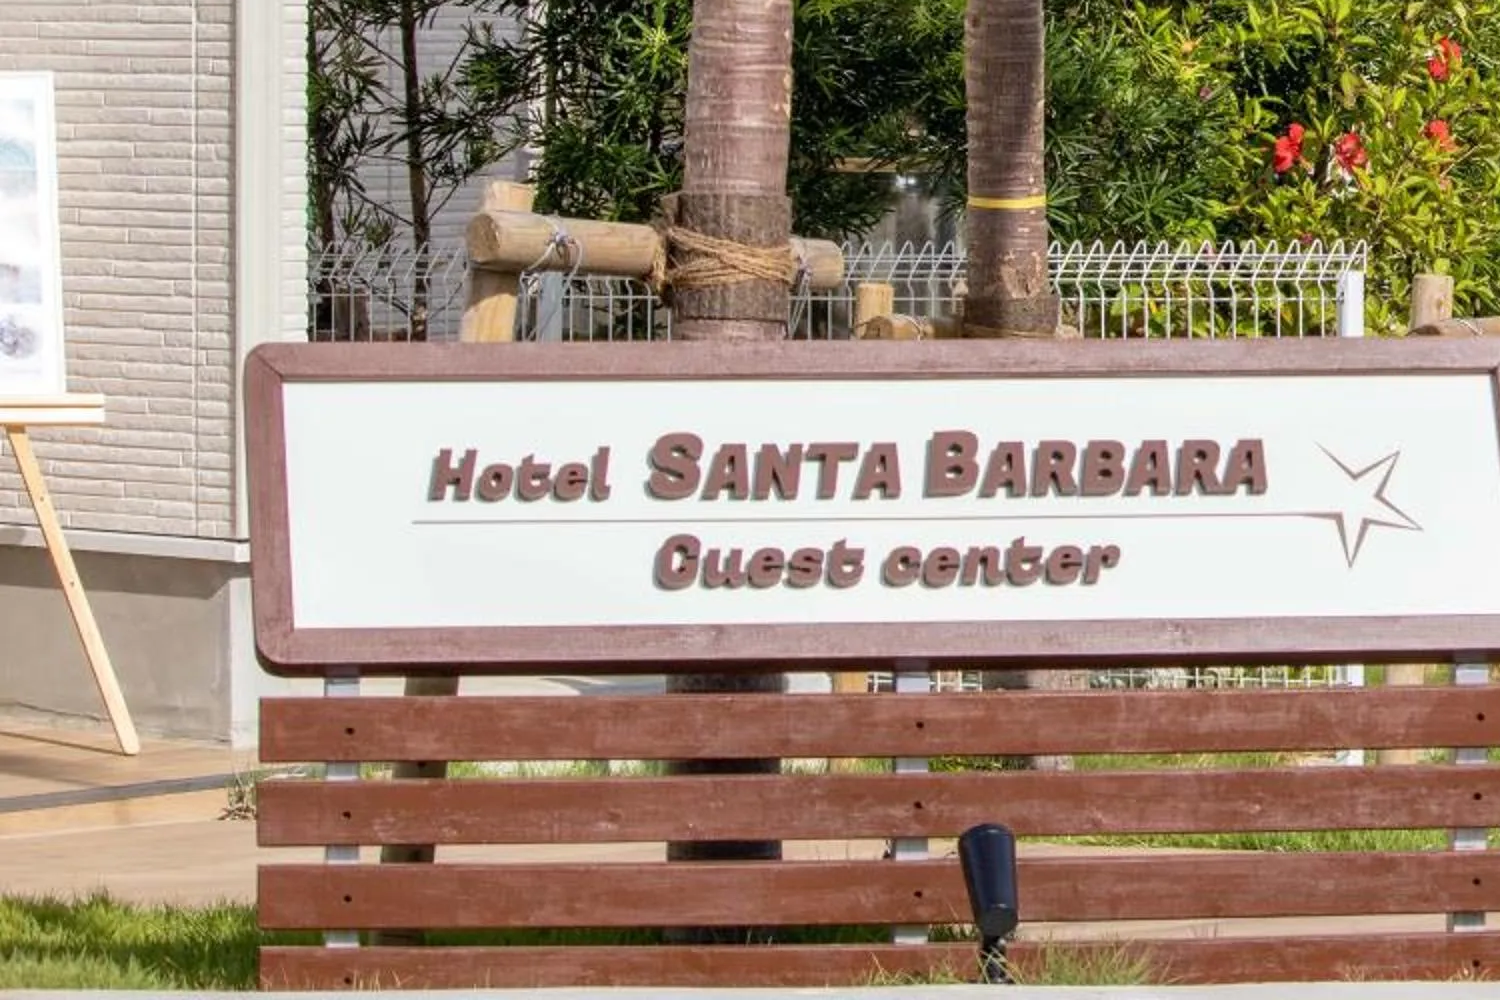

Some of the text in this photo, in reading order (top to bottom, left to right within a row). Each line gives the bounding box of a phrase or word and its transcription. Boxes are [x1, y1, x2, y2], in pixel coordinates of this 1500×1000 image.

[429, 430, 1269, 502] Hotel SANTA BARBARA
[653, 534, 1121, 590] Guest center
